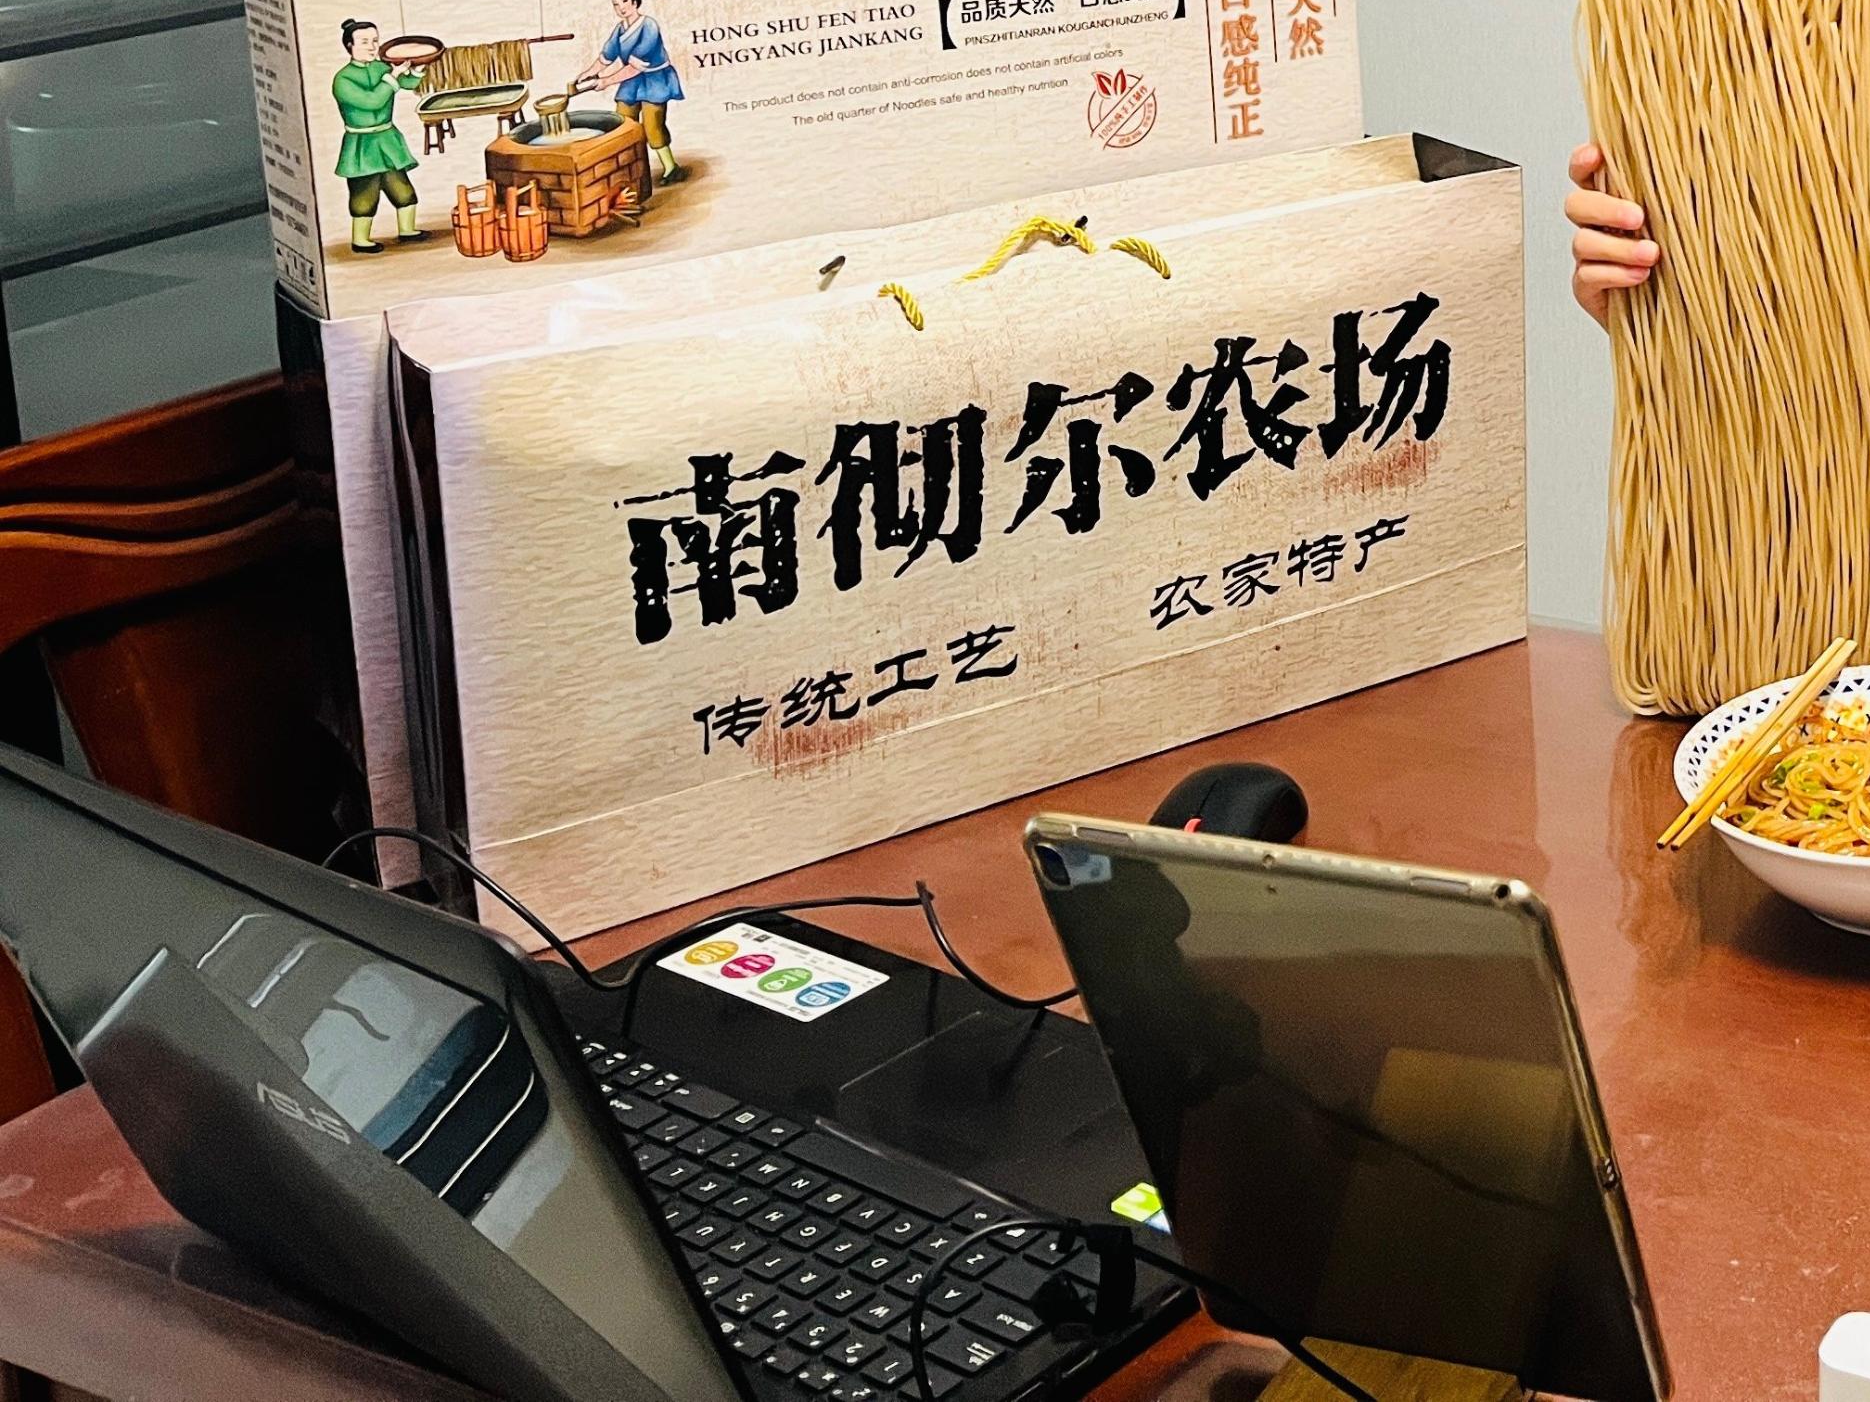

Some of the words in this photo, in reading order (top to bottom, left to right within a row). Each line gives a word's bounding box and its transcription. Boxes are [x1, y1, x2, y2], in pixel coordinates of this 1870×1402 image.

[691, 24, 759, 45] HONG
[767, 16, 810, 35] SHU
[818, 10, 857, 29] FEN
[864, 3, 916, 23] TIAO
[694, 40, 813, 68] YINGYANG
[818, 26, 924, 57] JIANKANG
[724, 101, 748, 112] This
[751, 93, 795, 111] product
[796, 91, 825, 102] does
[827, 87, 846, 97] not
[848, 81, 888, 95] contain
[890, 69, 963, 89] anti-corrosion
[966, 68, 992, 79] does
[995, 65, 1012, 74] not
[1014, 58, 1051, 72] contain
[1053, 52, 1092, 66] artificial
[1093, 48, 1124, 60] colors
[793, 116, 814, 126] The
[817, 112, 834, 123] old
[837, 106, 876, 120] quarter
[879, 104, 891, 114] of
[893, 98, 937, 111] Noodles
[939, 94, 963, 105] safe
[965, 90, 985, 101] and
[988, 83, 1025, 98] healthy
[1028, 78, 1069, 92] nutrition
[614, 291, 1453, 646] 南彻尔农场
[1152, 512, 1413, 632] 农家特产
[694, 623, 1017, 757] 传统工艺
